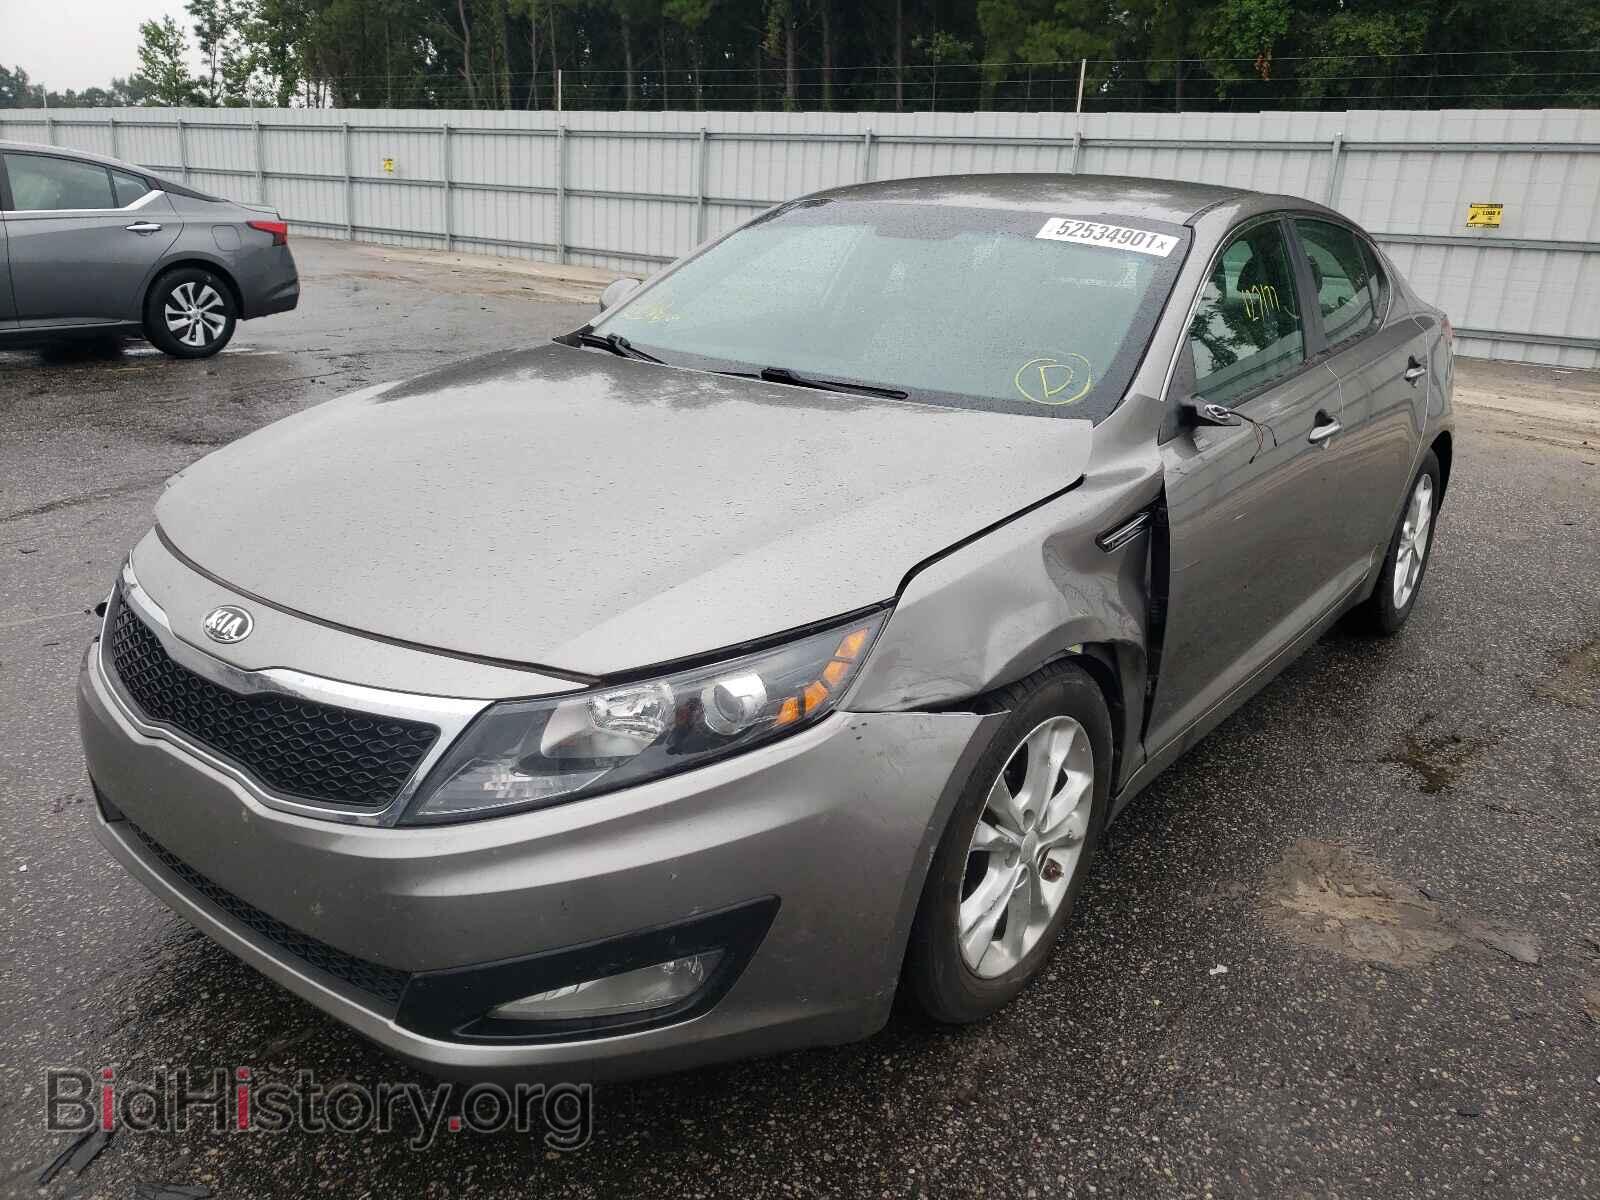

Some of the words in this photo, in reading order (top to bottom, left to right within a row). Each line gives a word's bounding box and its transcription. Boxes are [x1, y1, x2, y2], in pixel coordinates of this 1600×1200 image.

[1056, 220, 1158, 248] 52534901
[1038, 364, 1074, 398] D
[205, 609, 243, 638] KIA
